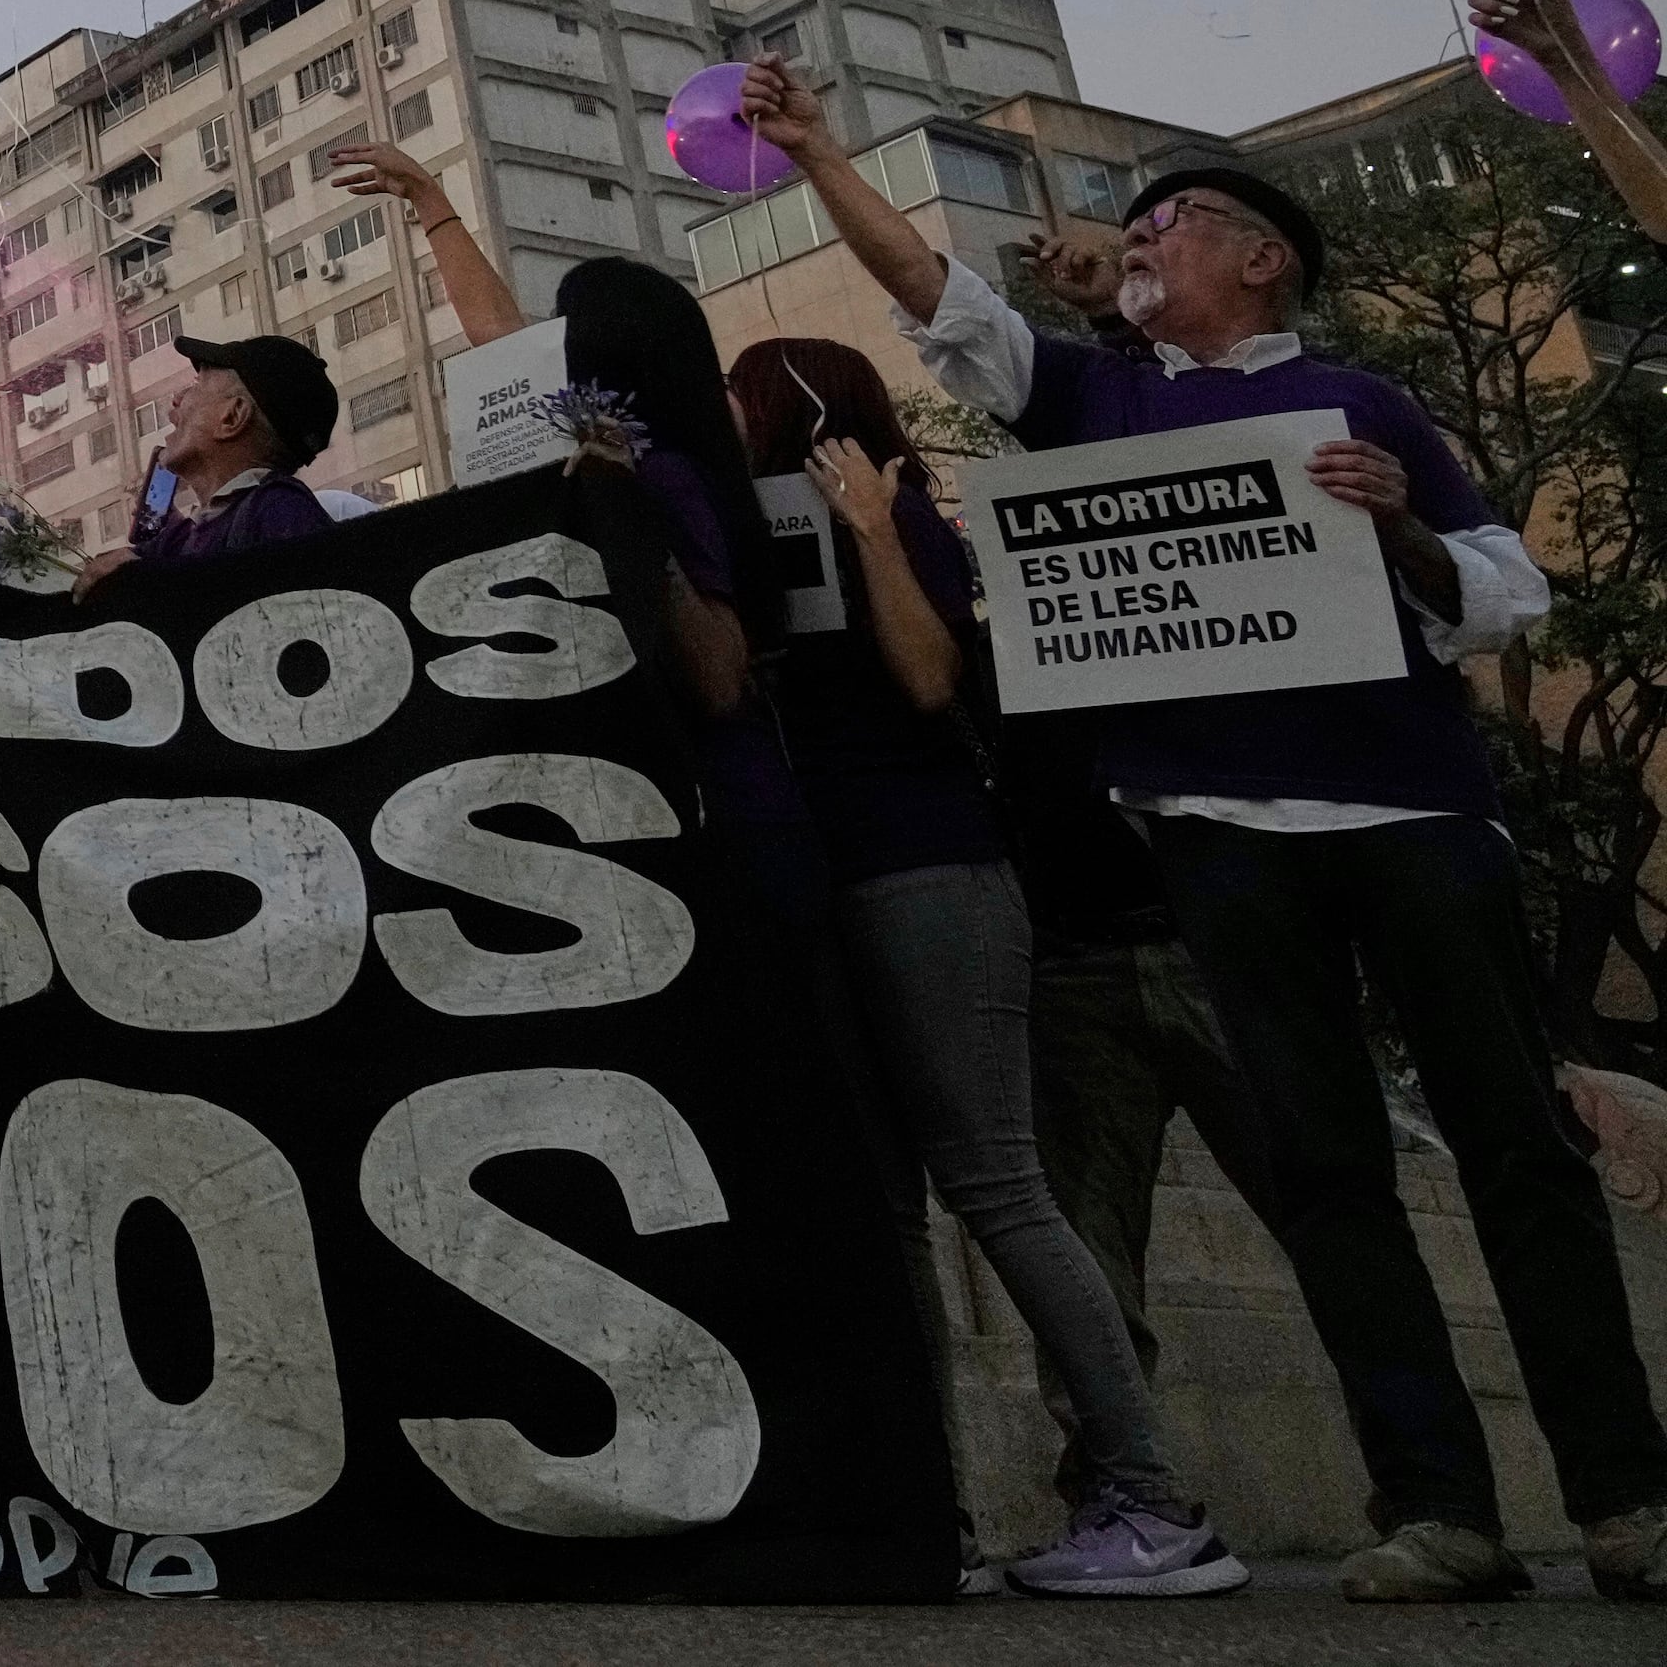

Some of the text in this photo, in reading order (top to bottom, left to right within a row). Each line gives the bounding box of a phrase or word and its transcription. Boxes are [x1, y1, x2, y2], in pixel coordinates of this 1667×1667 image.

[478, 378, 531, 411] JESÚS
[476, 396, 539, 432] ARMAS
[466, 439, 511, 463] DERECHOS
[479, 422, 524, 446] DEFENSOR
[466, 444, 526, 473] SECUESTRADO
[526, 435, 545, 448] POR
[489, 449, 538, 475] DICTADURA
[1004, 473, 1269, 538] LA TORTURA
[1019, 521, 1318, 588] ES UN CRIMEN
[1027, 580, 1200, 626] DE LESA
[1034, 609, 1299, 666] HUMANIDAD
